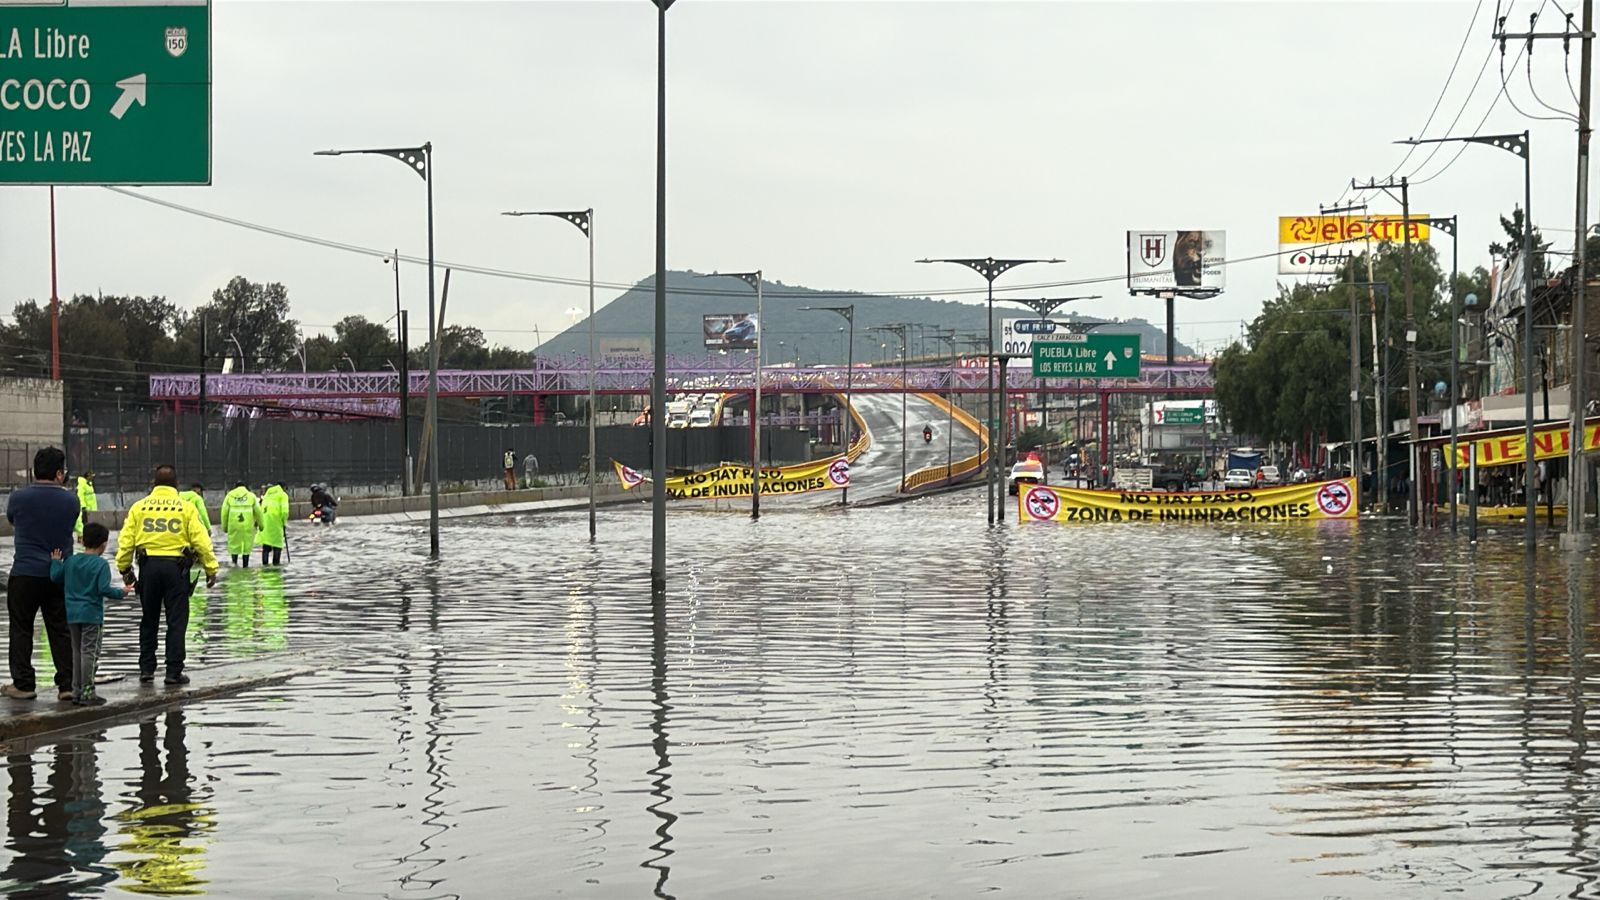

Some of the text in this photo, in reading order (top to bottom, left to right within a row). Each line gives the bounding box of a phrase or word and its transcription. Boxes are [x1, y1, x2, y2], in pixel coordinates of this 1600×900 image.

[0, 28, 90, 58] A Libre
[168, 39, 185, 49] 150
[0, 79, 91, 110] COCO
[34, 131, 54, 161] LA
[62, 131, 91, 161] PAZ
[1322, 216, 1419, 240] elektra
[1145, 239, 1162, 259] H
[1040, 348, 1097, 358] PUEBLA Libre
[1040, 363, 1097, 373] LOS REYES LA PAZ
[684, 475, 707, 485] NO
[711, 470, 737, 481] HAY
[692, 487, 710, 497] DE
[1121, 492, 1257, 504] NO HAY PASO,
[1067, 503, 1310, 521] ZONA DE INUNDACIONES
[143, 518, 182, 533] SSC
